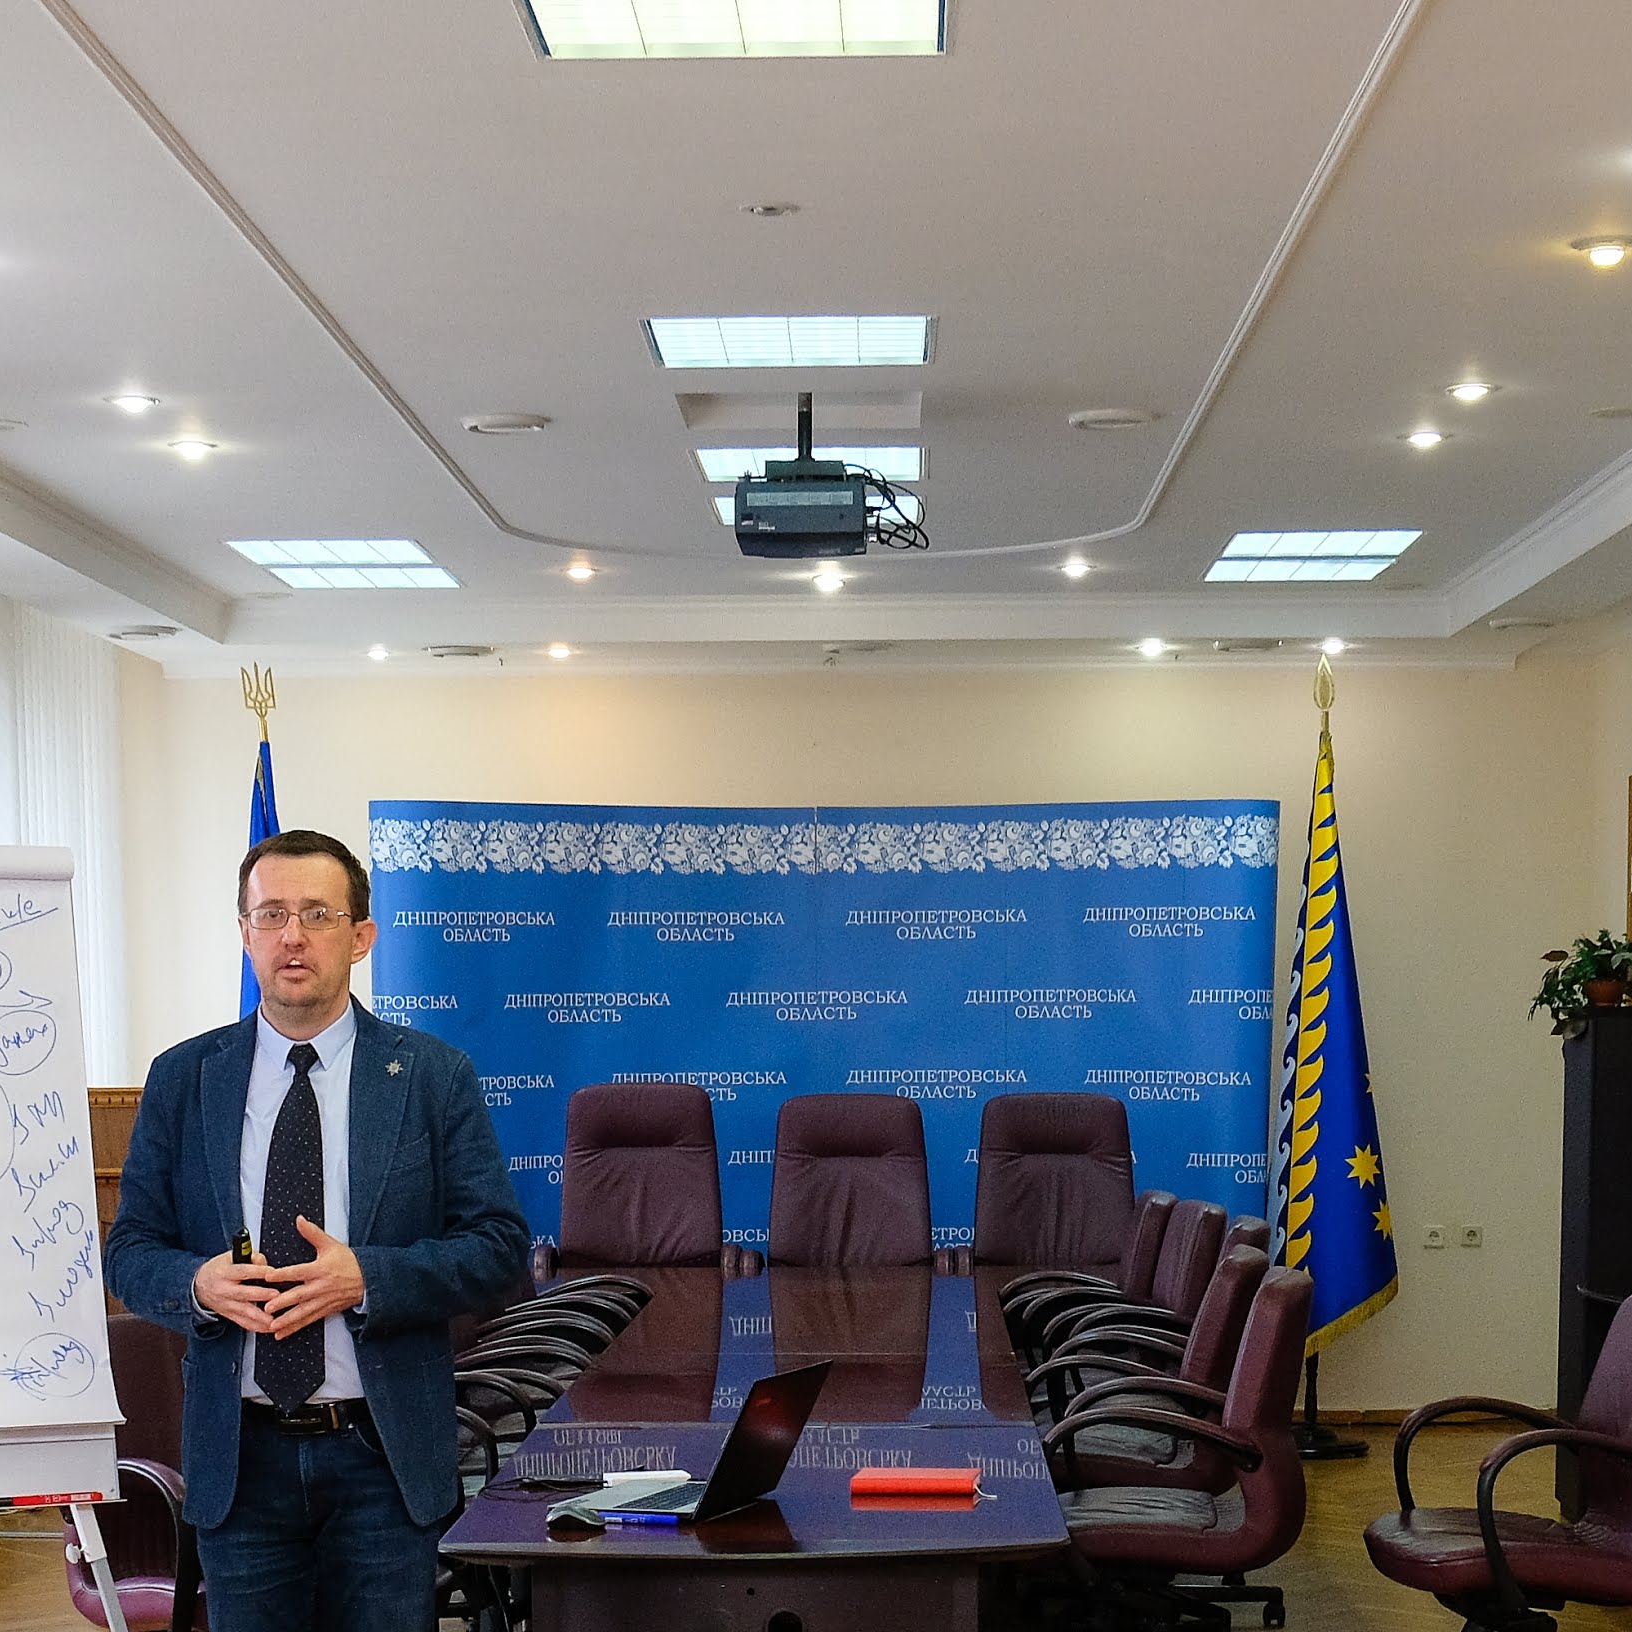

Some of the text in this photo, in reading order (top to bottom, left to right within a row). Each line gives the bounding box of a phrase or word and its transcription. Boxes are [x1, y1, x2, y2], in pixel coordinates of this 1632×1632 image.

[392, 911, 555, 927] ДНІПРОПЕТРОВСЬКА
[607, 911, 785, 927] ДНІПРОПЕТРОВСЬКА
[845, 909, 1027, 926] ДНІПРОПЕТРОВСЬКА
[1083, 907, 1256, 922] ДНІПРОПЕТРОВСЬКА
[443, 928, 511, 942] ОБЛАСТЬ
[657, 927, 735, 942] ОБЛАСТЬ
[896, 925, 977, 940] ОБЛАСТЬ
[1129, 923, 1204, 938] ОБЛАСТЬ
[504, 993, 670, 1009] ДНІПРОПЕТРОВСЬКА
[726, 990, 908, 1007] ДНІПРОПЕТРОВСЬКА
[964, 988, 1136, 1005] ДНІПРОПЕТРОВСЬКА
[1188, 989, 1273, 1005] ДНІПРОПЕ
[548, 1008, 622, 1023] ОБЛАСТЬ
[775, 1006, 857, 1021] ОБЛАСТЬ
[1015, 1004, 1092, 1019] ОБЛАСТЬ
[478, 1075, 555, 1091] ТРОВСЬКА
[846, 1069, 1027, 1085] ДНІПРОПЕТРОВСЬКА
[1085, 1069, 1251, 1086] ДНІПРОПЕТРОВСЬКА
[896, 1085, 977, 1100] ОБЛАСТЬ
[1129, 1086, 1200, 1102] ОБЛАСТЬ
[1186, 1153, 1266, 1168] ДНІПРОПЕ
